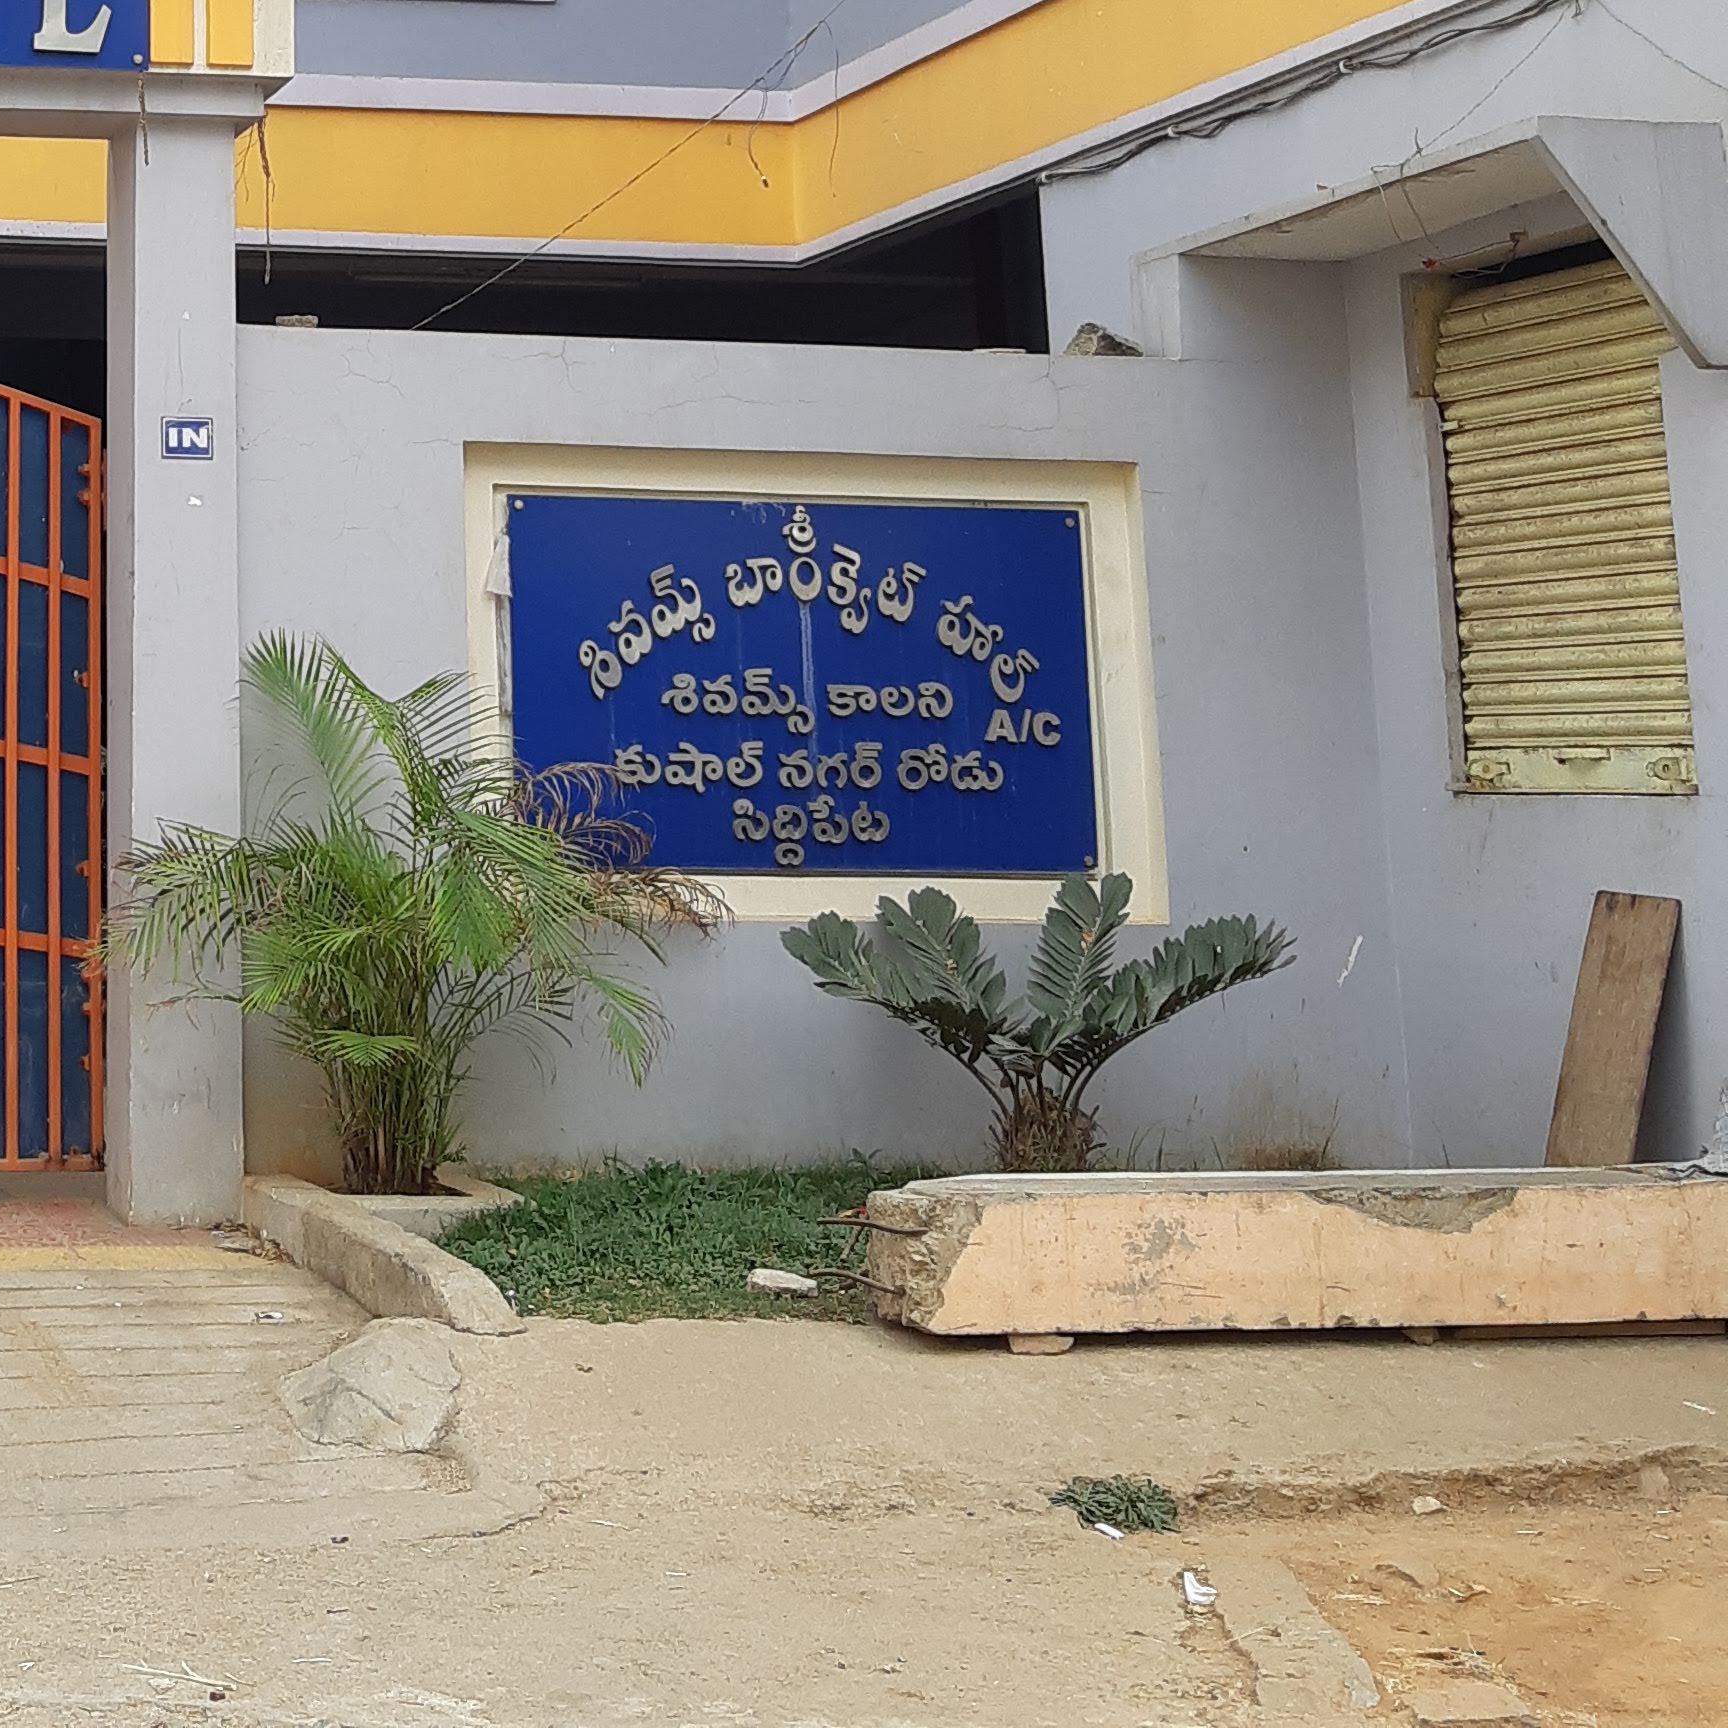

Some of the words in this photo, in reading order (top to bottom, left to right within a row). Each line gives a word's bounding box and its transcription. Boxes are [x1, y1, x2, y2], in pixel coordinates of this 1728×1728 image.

[168, 427, 208, 448] IN
[782, 505, 816, 554] శ్రీ
[826, 681, 954, 718] కాలని
[984, 708, 1061, 746] A/C
[778, 742, 883, 789] నగర్
